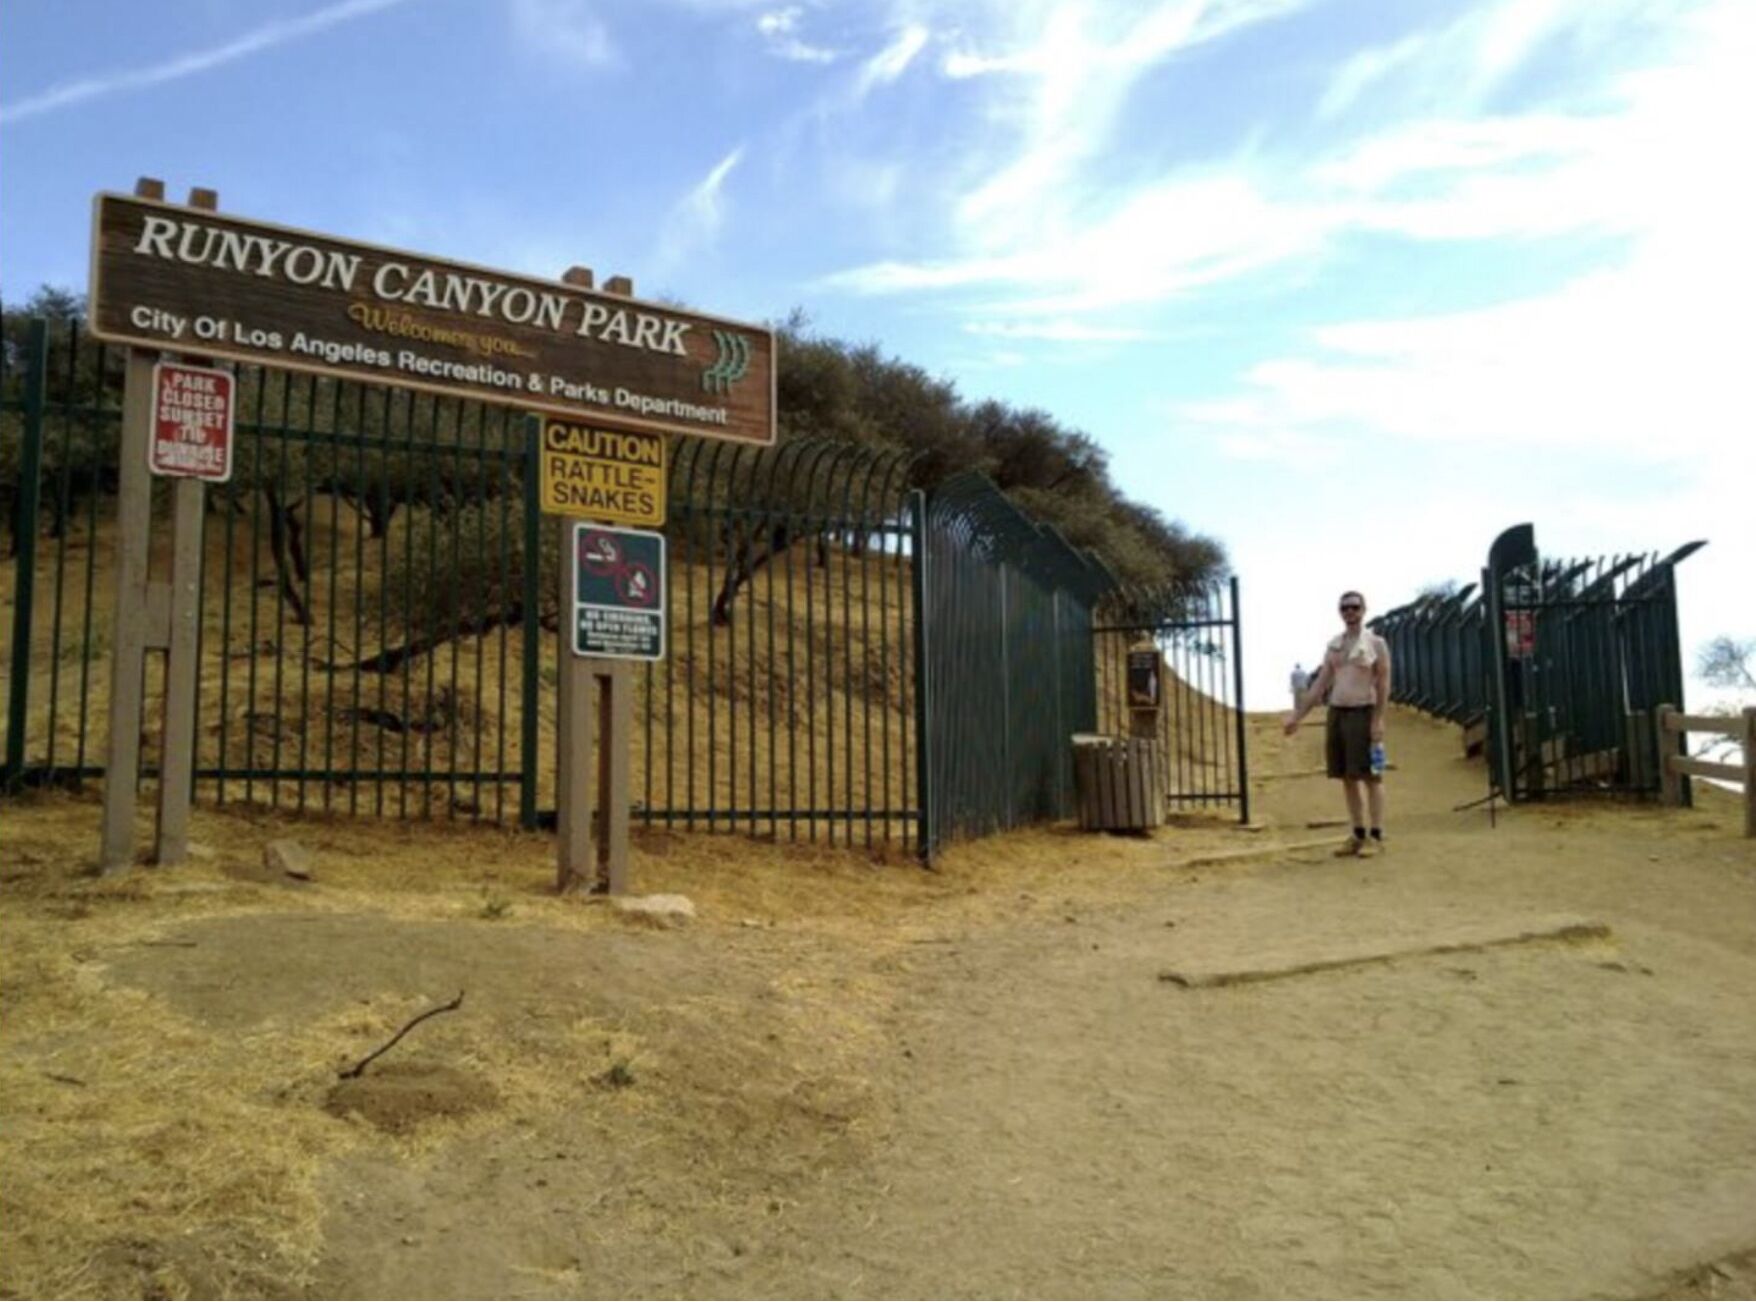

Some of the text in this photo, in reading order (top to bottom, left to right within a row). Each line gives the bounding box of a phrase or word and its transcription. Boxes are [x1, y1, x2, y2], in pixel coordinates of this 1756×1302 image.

[134, 216, 692, 356] RUNYON CANYON PARK
[131, 306, 728, 425] City Of Los Angeles Recreation & Parks Department
[172, 372, 217, 393] PARK
[162, 388, 226, 411] CLOSED
[547, 423, 660, 464] CAUTION
[550, 457, 656, 490] RATTLE-
[553, 481, 655, 515] SNAKES
